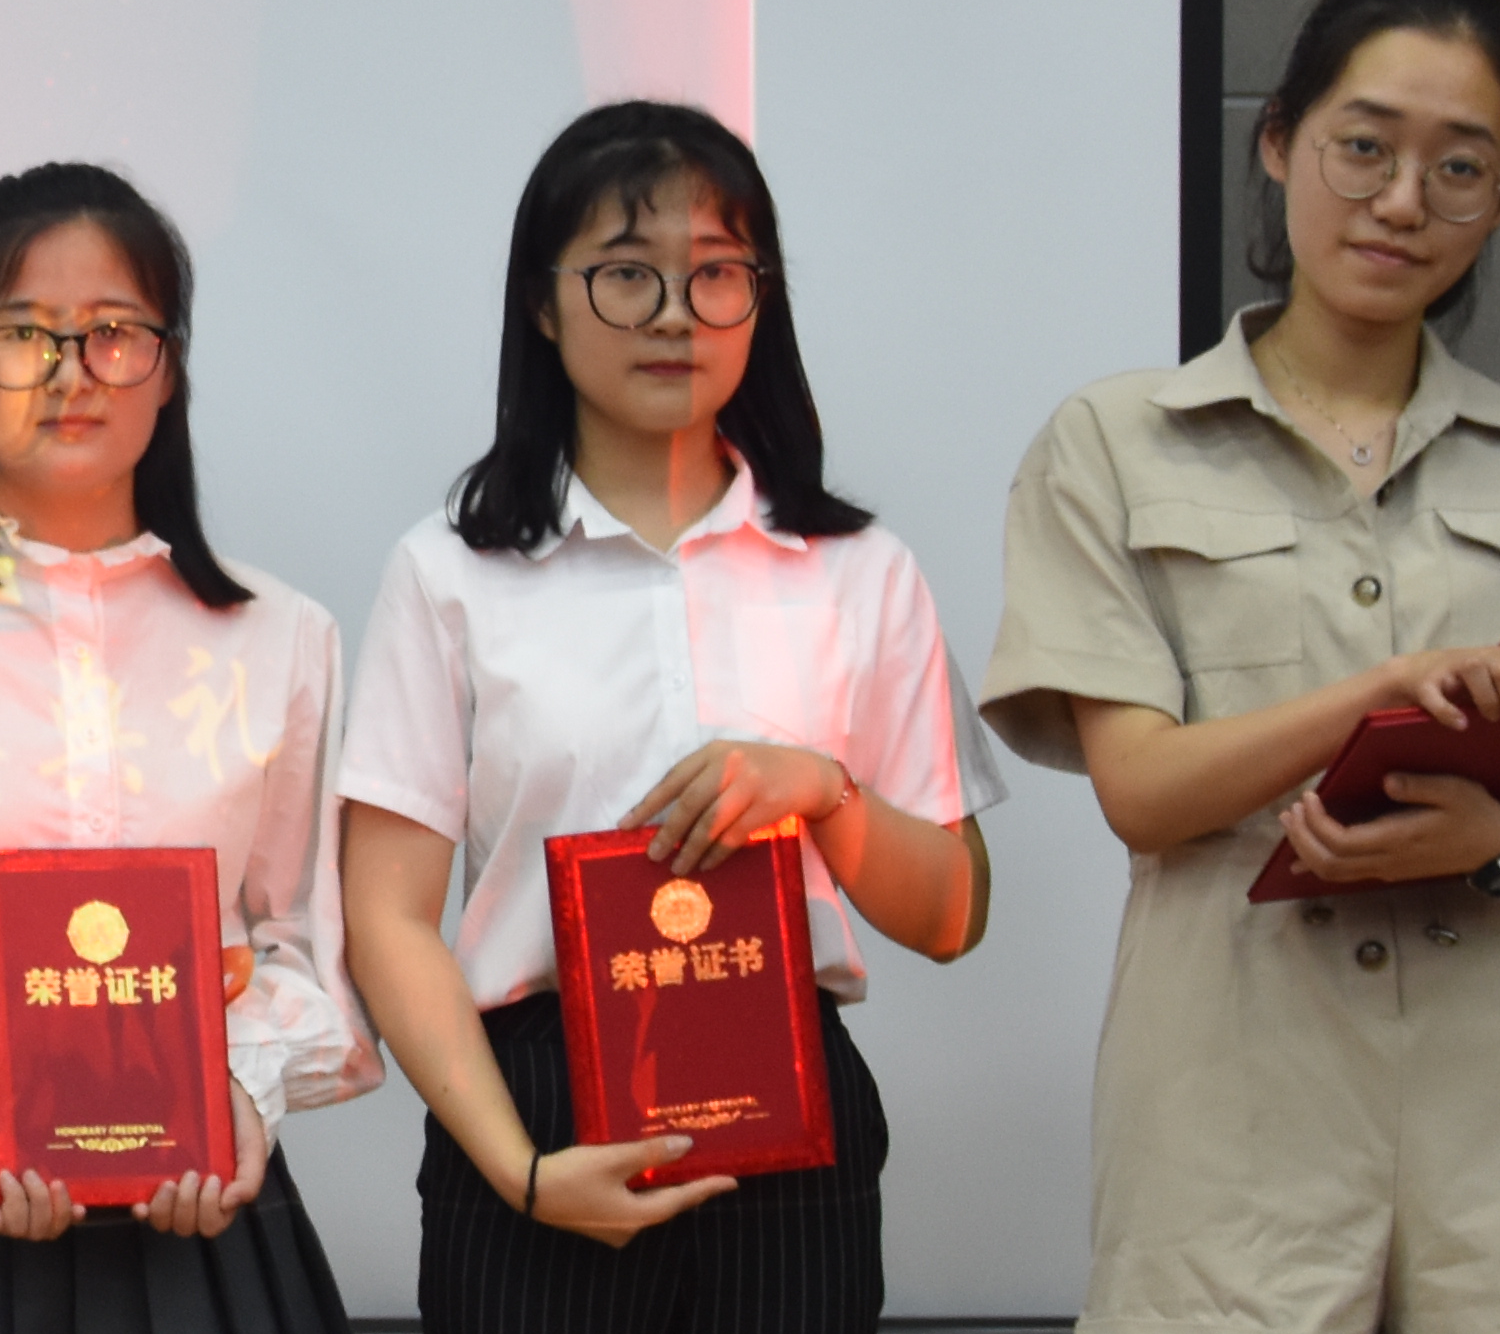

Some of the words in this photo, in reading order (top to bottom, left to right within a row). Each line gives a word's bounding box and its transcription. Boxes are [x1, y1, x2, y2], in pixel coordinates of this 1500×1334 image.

[25, 965, 178, 1007] 荣誉证书
[610, 936, 763, 991] 荣誉证书
